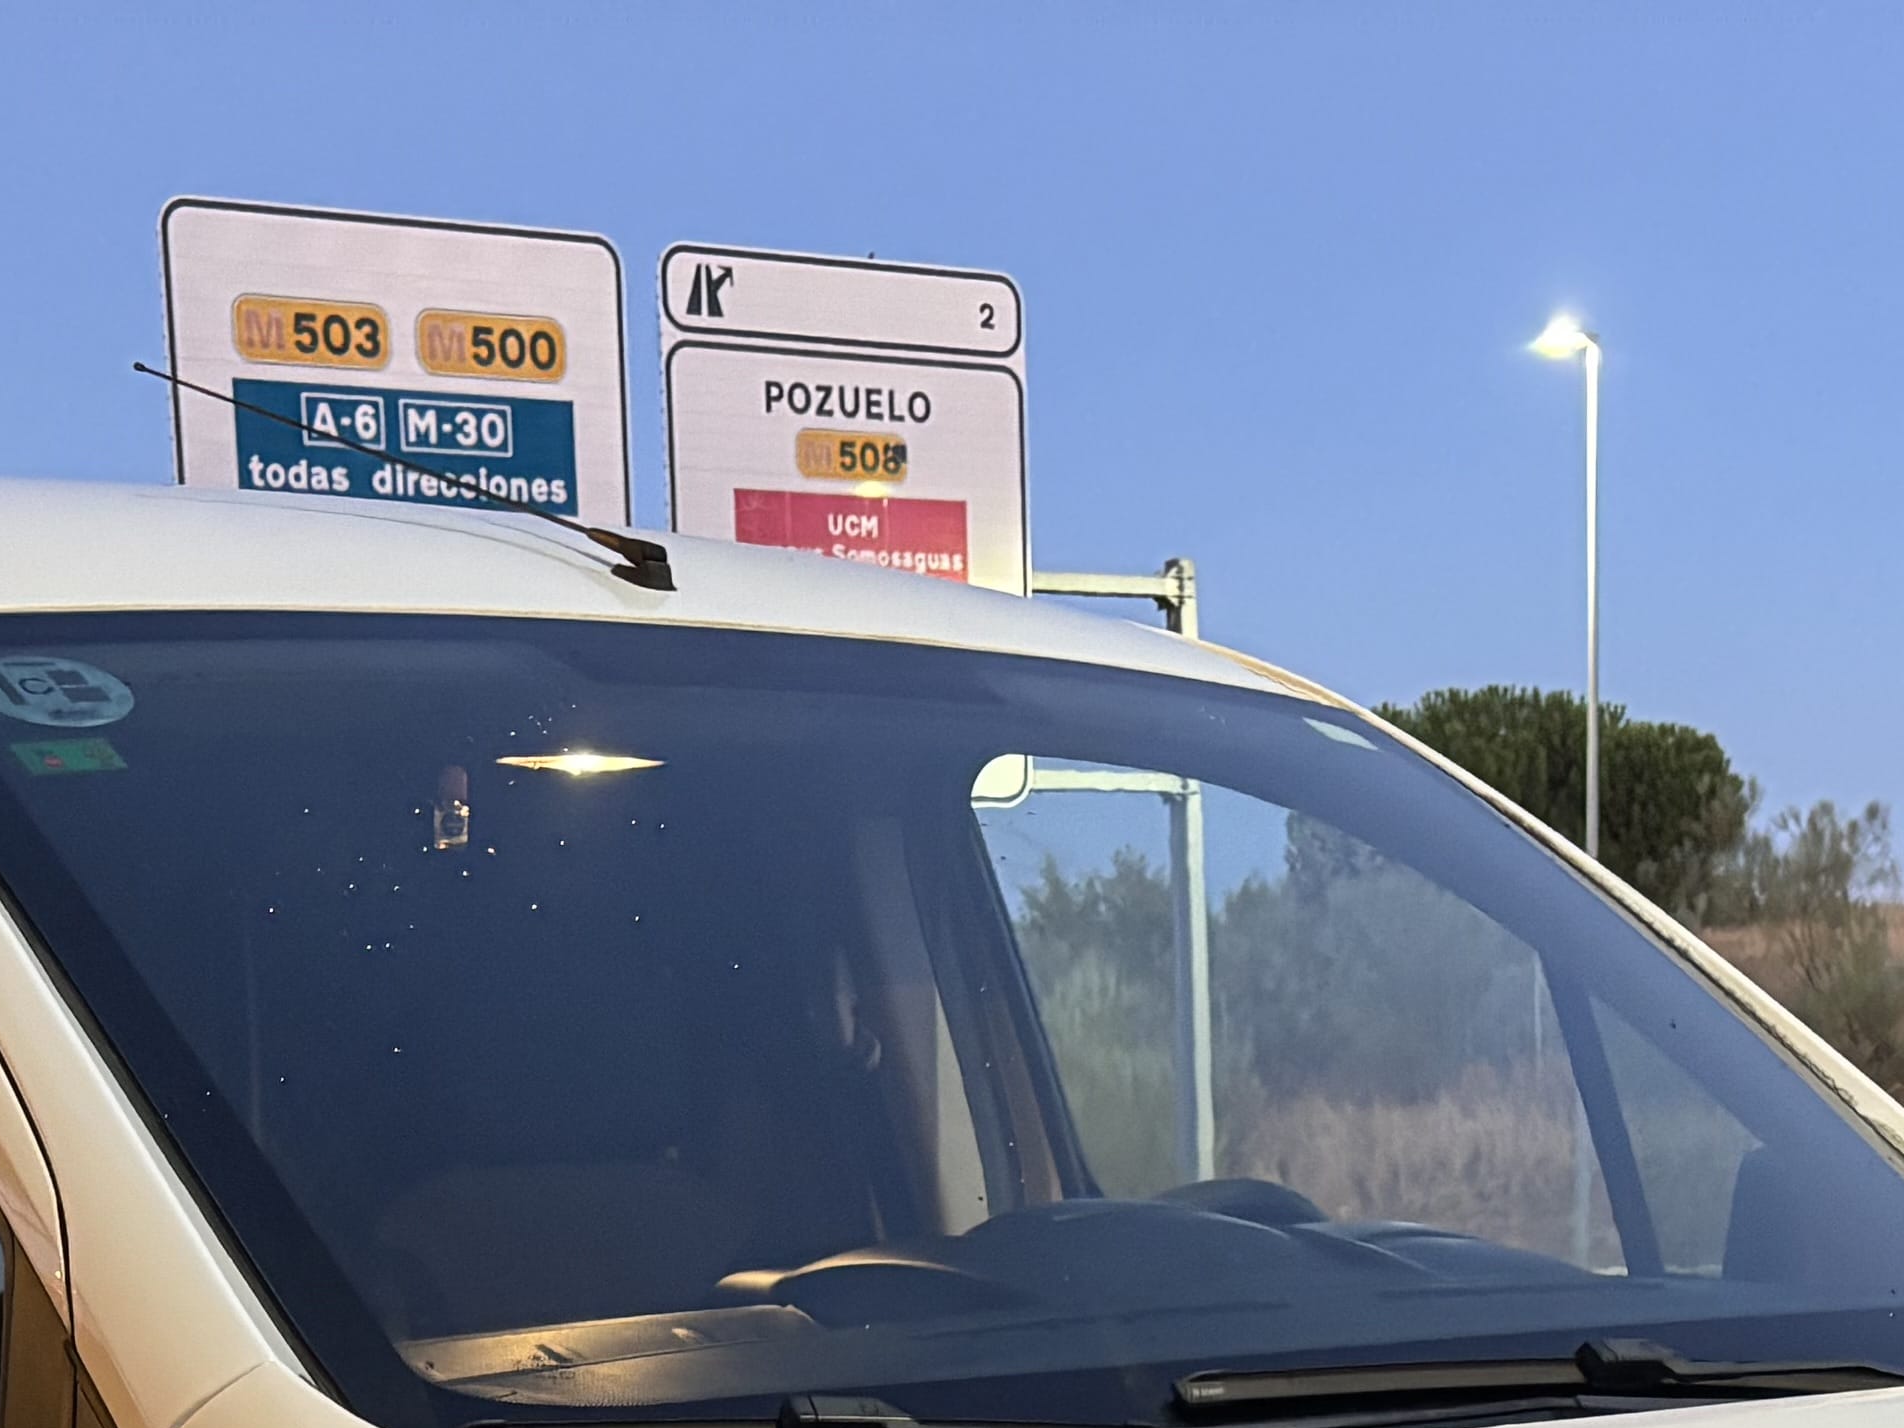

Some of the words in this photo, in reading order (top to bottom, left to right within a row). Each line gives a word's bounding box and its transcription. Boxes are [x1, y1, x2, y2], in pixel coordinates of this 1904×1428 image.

[978, 302, 995, 330] 2
[764, 380, 931, 424] POZUELO
[311, 401, 378, 441] A-6
[406, 408, 506, 449] M-30
[249, 454, 350, 492] todas
[372, 460, 569, 504] direcciones
[827, 513, 879, 539] UCM
